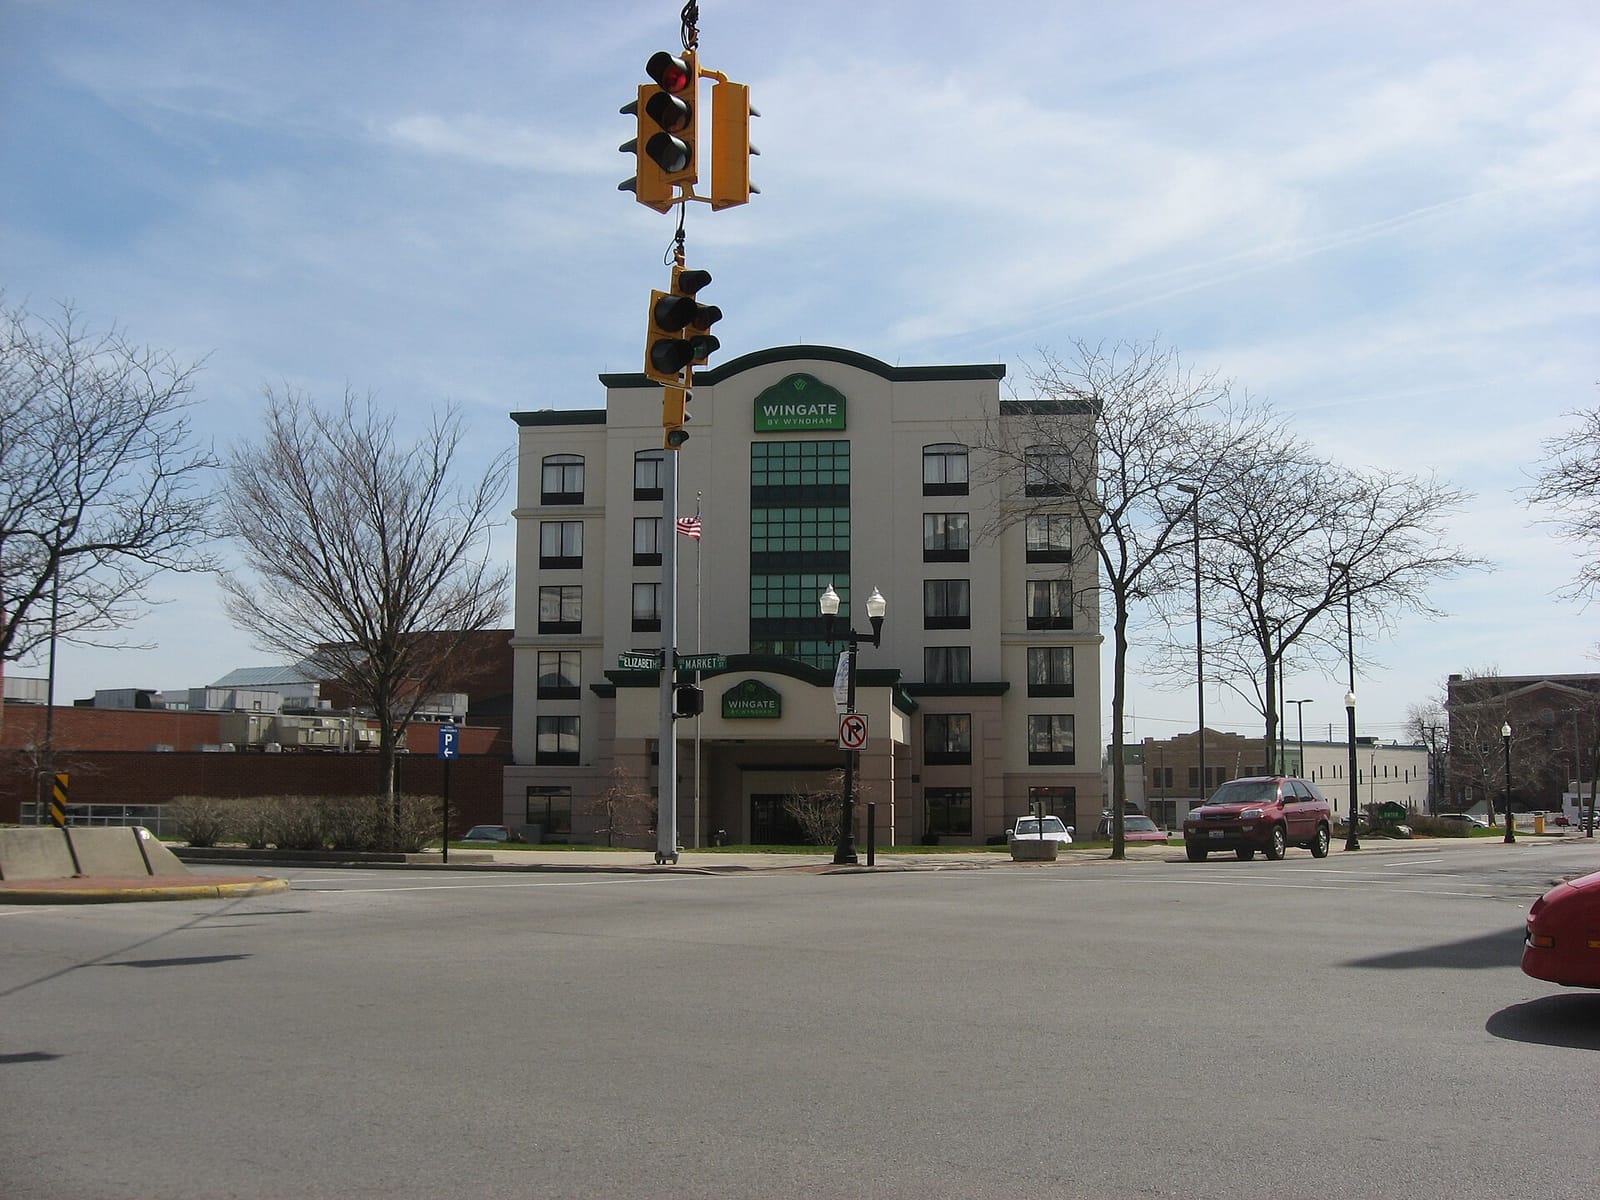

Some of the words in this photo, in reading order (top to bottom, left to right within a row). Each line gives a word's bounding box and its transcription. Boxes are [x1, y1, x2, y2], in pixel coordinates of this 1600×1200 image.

[763, 404, 837, 416] WINGATE
[624, 656, 657, 669] ELIZABETH
[685, 658, 717, 669] MARKET
[728, 700, 775, 708] WINGATE
[445, 733, 453, 746] P
